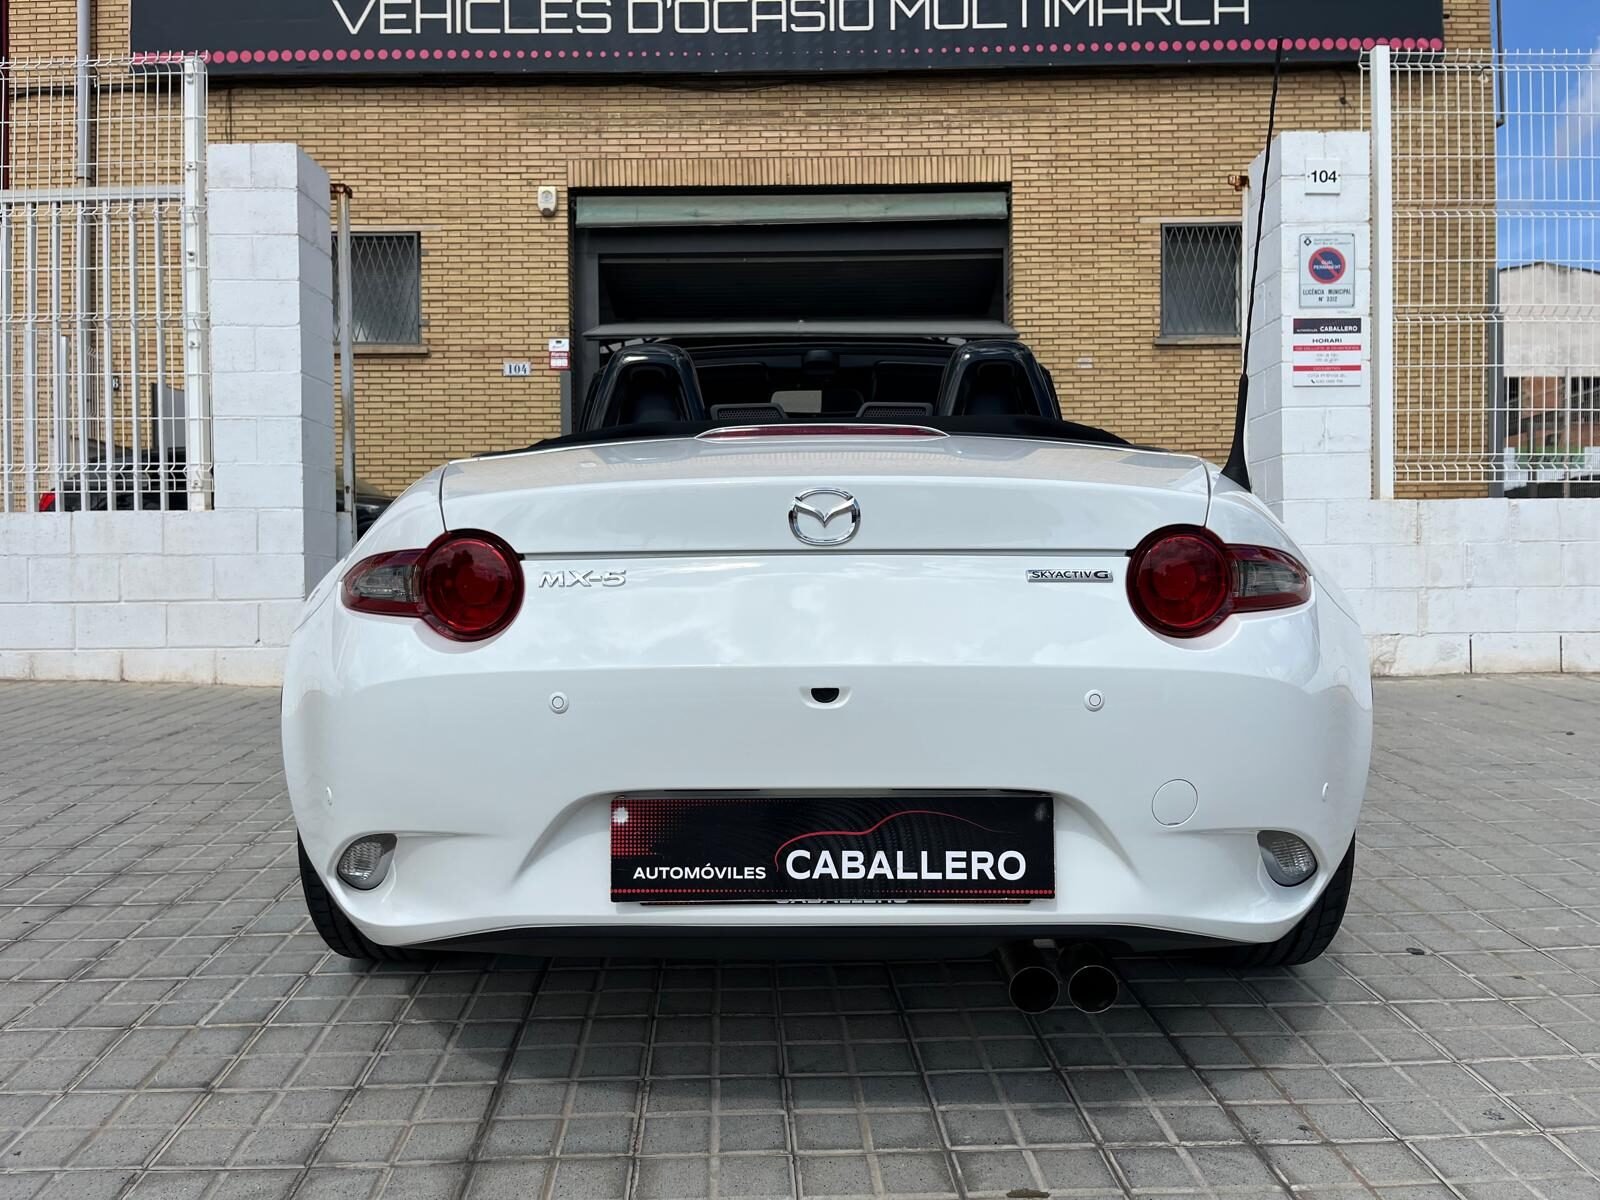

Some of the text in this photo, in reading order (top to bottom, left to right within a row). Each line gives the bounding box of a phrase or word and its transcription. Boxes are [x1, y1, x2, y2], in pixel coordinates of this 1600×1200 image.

[332, 0, 612, 35] VEHICLES
[628, 0, 874, 34] D'OCASIO
[1311, 170, 1337, 183] 104
[508, 364, 527, 374] 104
[538, 570, 627, 588] MX-5
[633, 849, 1027, 881] AUTOMÓVILES CABALLERO
